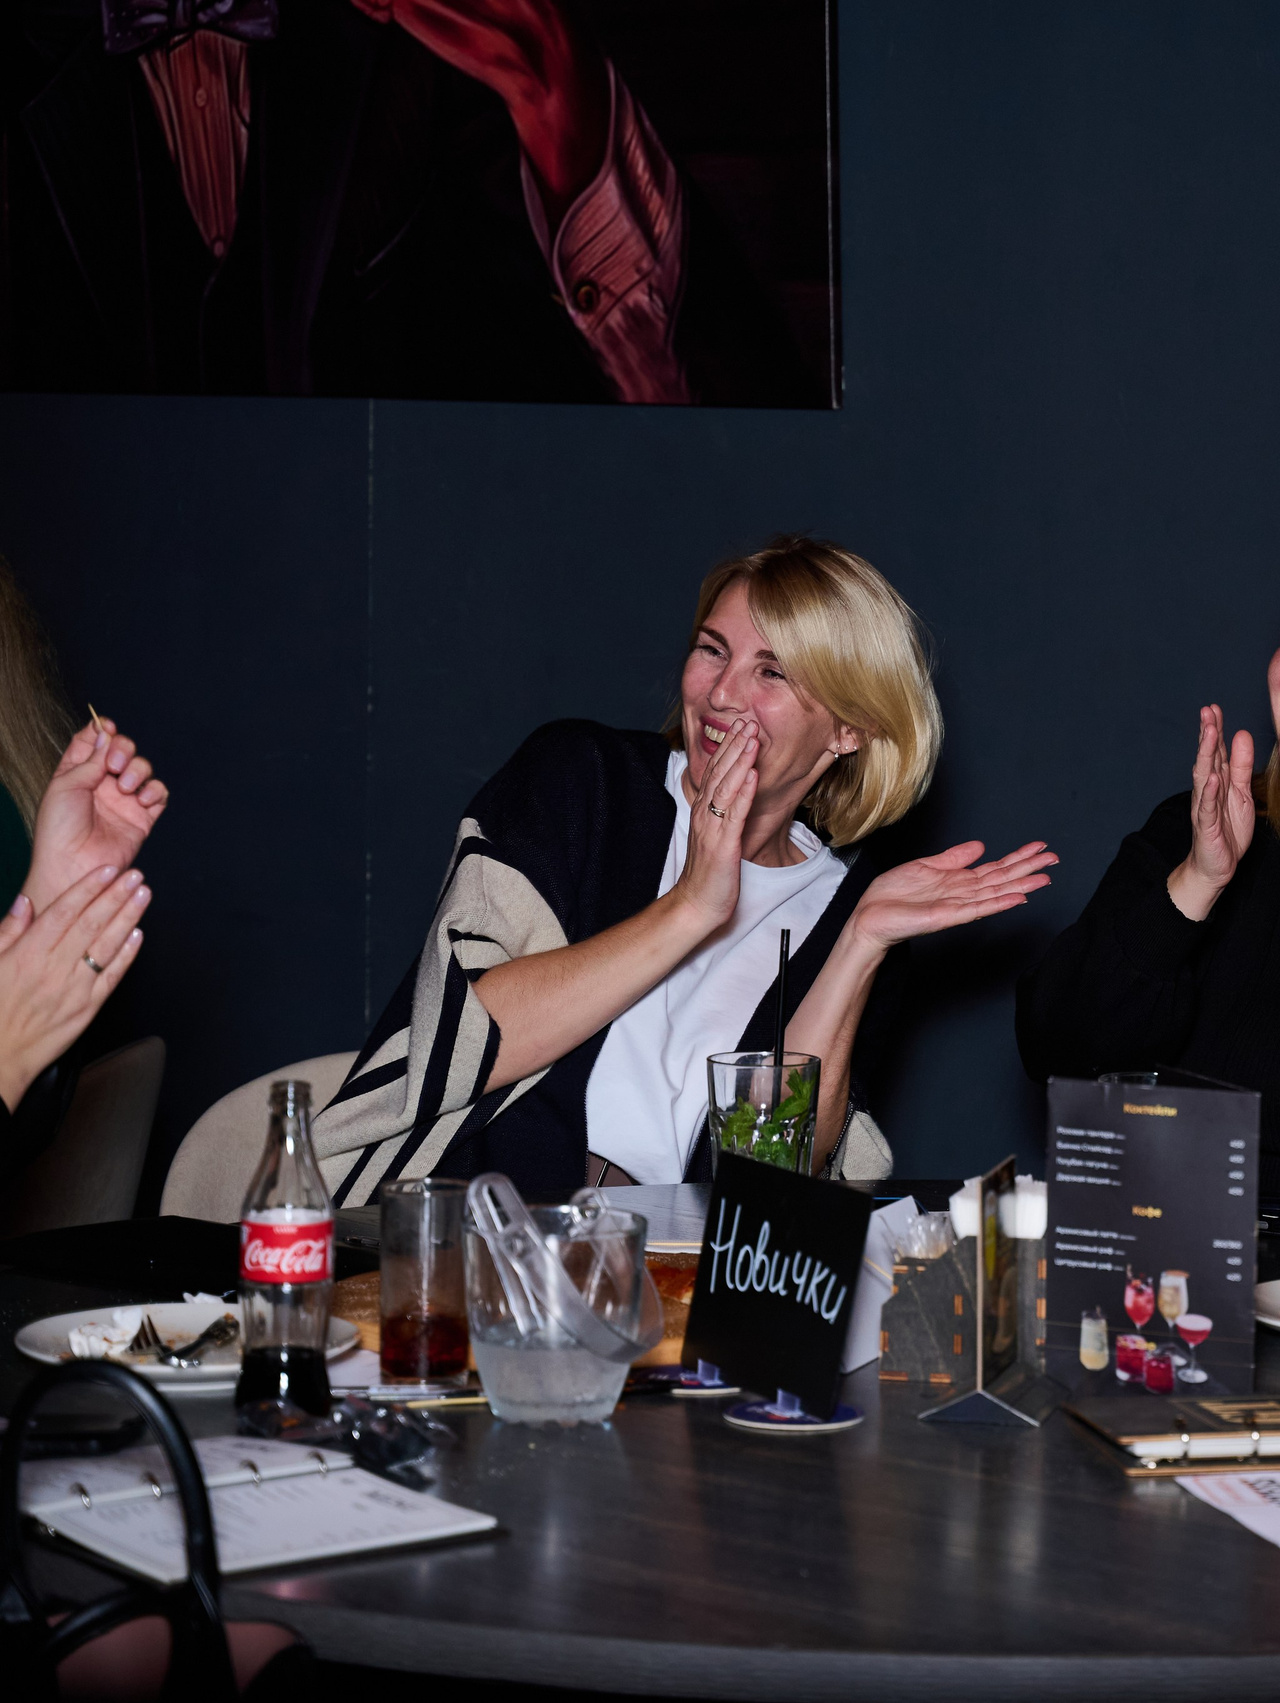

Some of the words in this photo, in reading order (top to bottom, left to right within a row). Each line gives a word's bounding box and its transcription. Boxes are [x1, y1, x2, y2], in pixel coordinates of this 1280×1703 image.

[1123, 1102, 1178, 1117] Коктейли
[1131, 1205, 1162, 1220] Кофе
[710, 1196, 848, 1325] Новички
